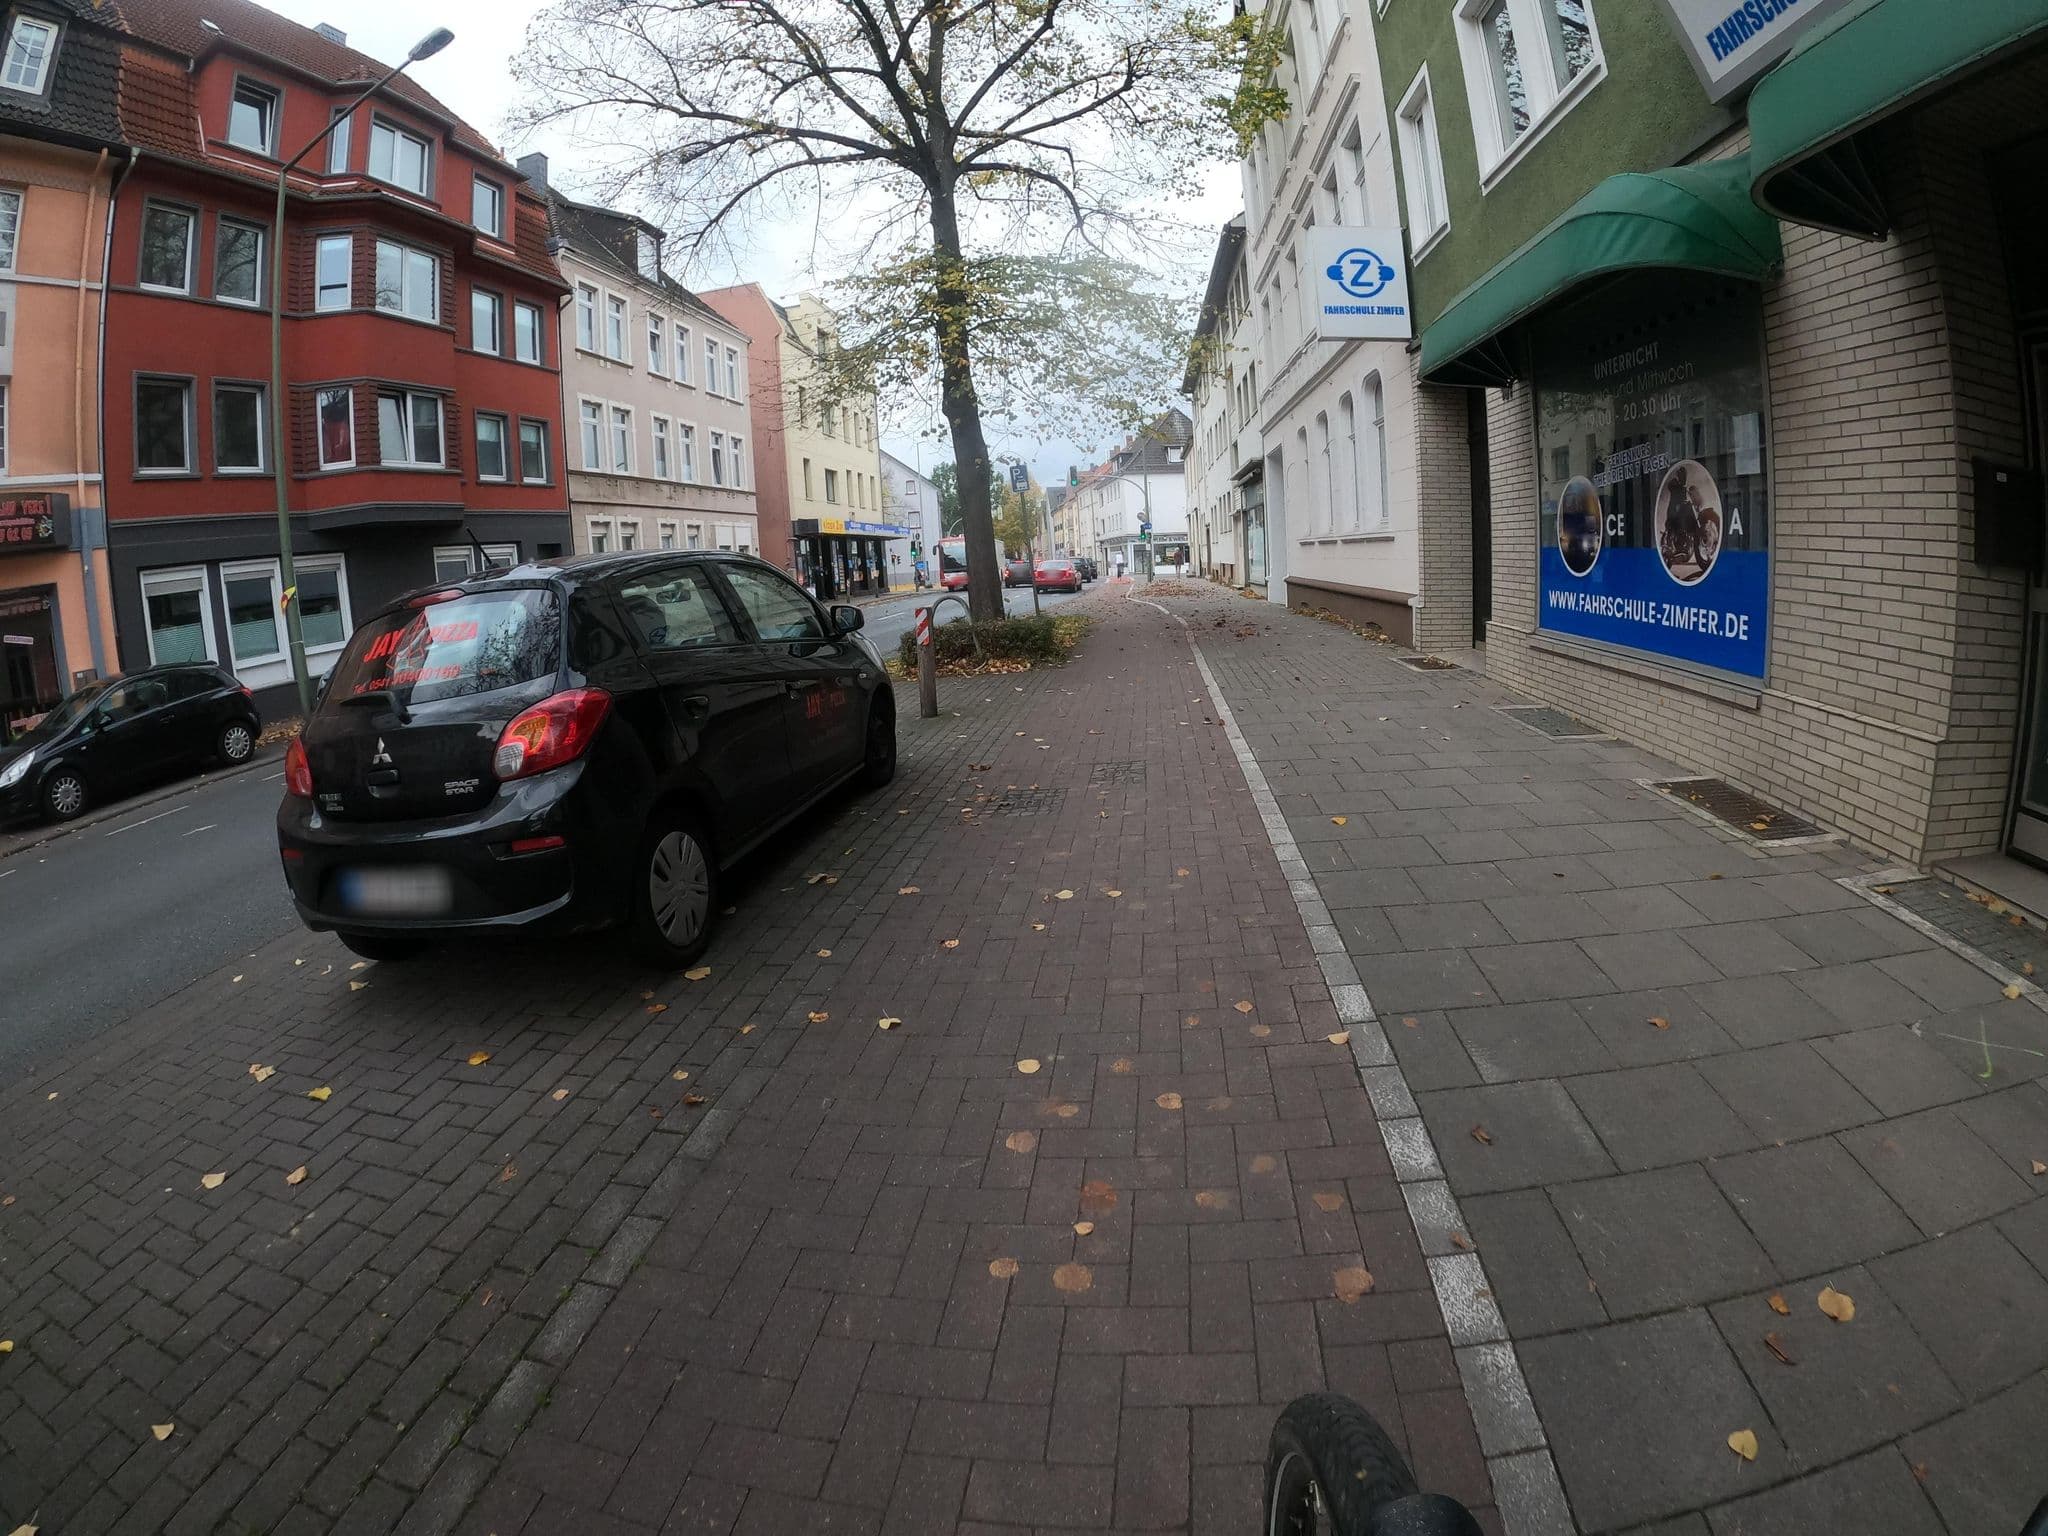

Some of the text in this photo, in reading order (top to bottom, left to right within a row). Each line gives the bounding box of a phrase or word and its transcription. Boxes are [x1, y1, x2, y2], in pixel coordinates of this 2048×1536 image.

[1350, 259, 1374, 287] Z
[1324, 305, 1405, 316] FAHRSCHULE ZIMFER
[1594, 342, 1660, 381] UNTERRICHT
[1638, 360, 1695, 393] Mittwoch
[1660, 392, 1683, 413] Uhr
[1606, 513, 1625, 537] CE
[1728, 507, 1744, 536] A
[1548, 590, 1749, 641] WWW.FAHRSCHULE-ZIMFER.DE
[363, 621, 480, 664] JAY PIZZA
[444, 778, 480, 789] SPACE
[445, 786, 475, 796] STAR
